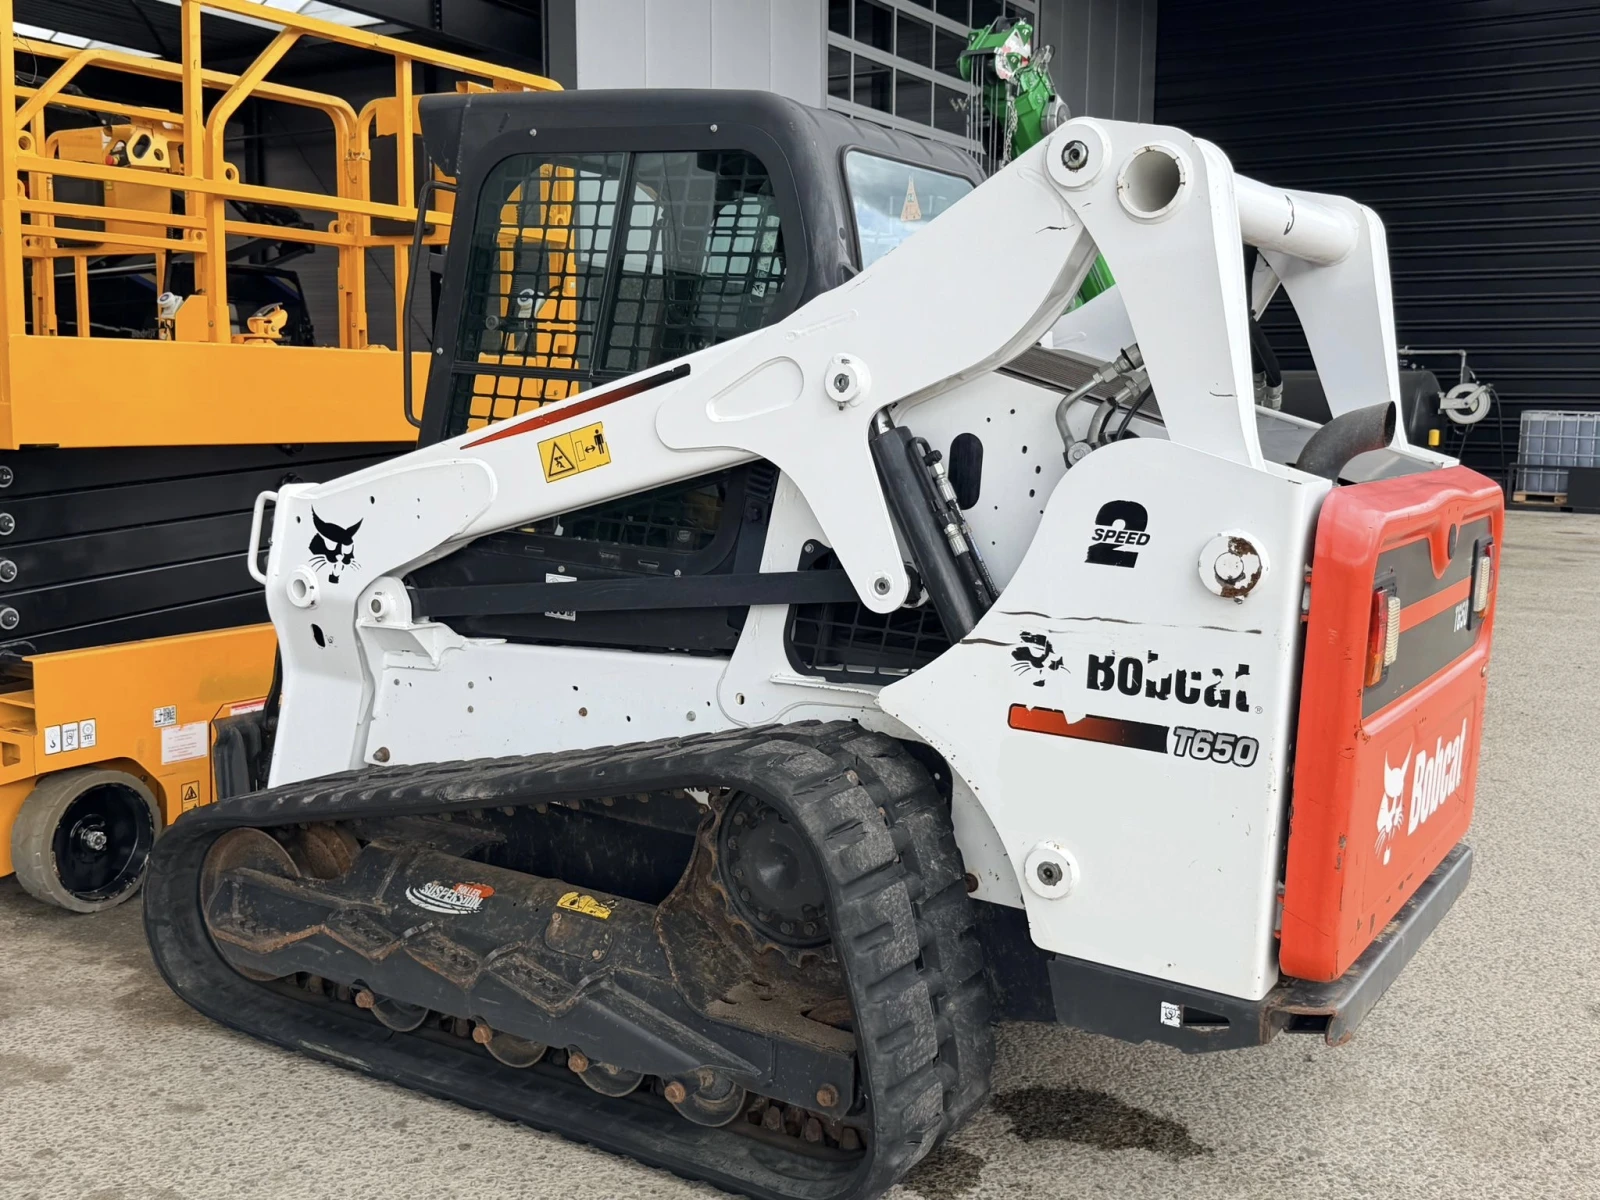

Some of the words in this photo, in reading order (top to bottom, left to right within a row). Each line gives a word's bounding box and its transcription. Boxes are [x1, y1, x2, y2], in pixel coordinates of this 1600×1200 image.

[1084, 500, 1148, 568] 2
[1092, 528, 1151, 546] SPEED
[1173, 726, 1260, 768] T650
[1407, 717, 1467, 836] Bobcat
